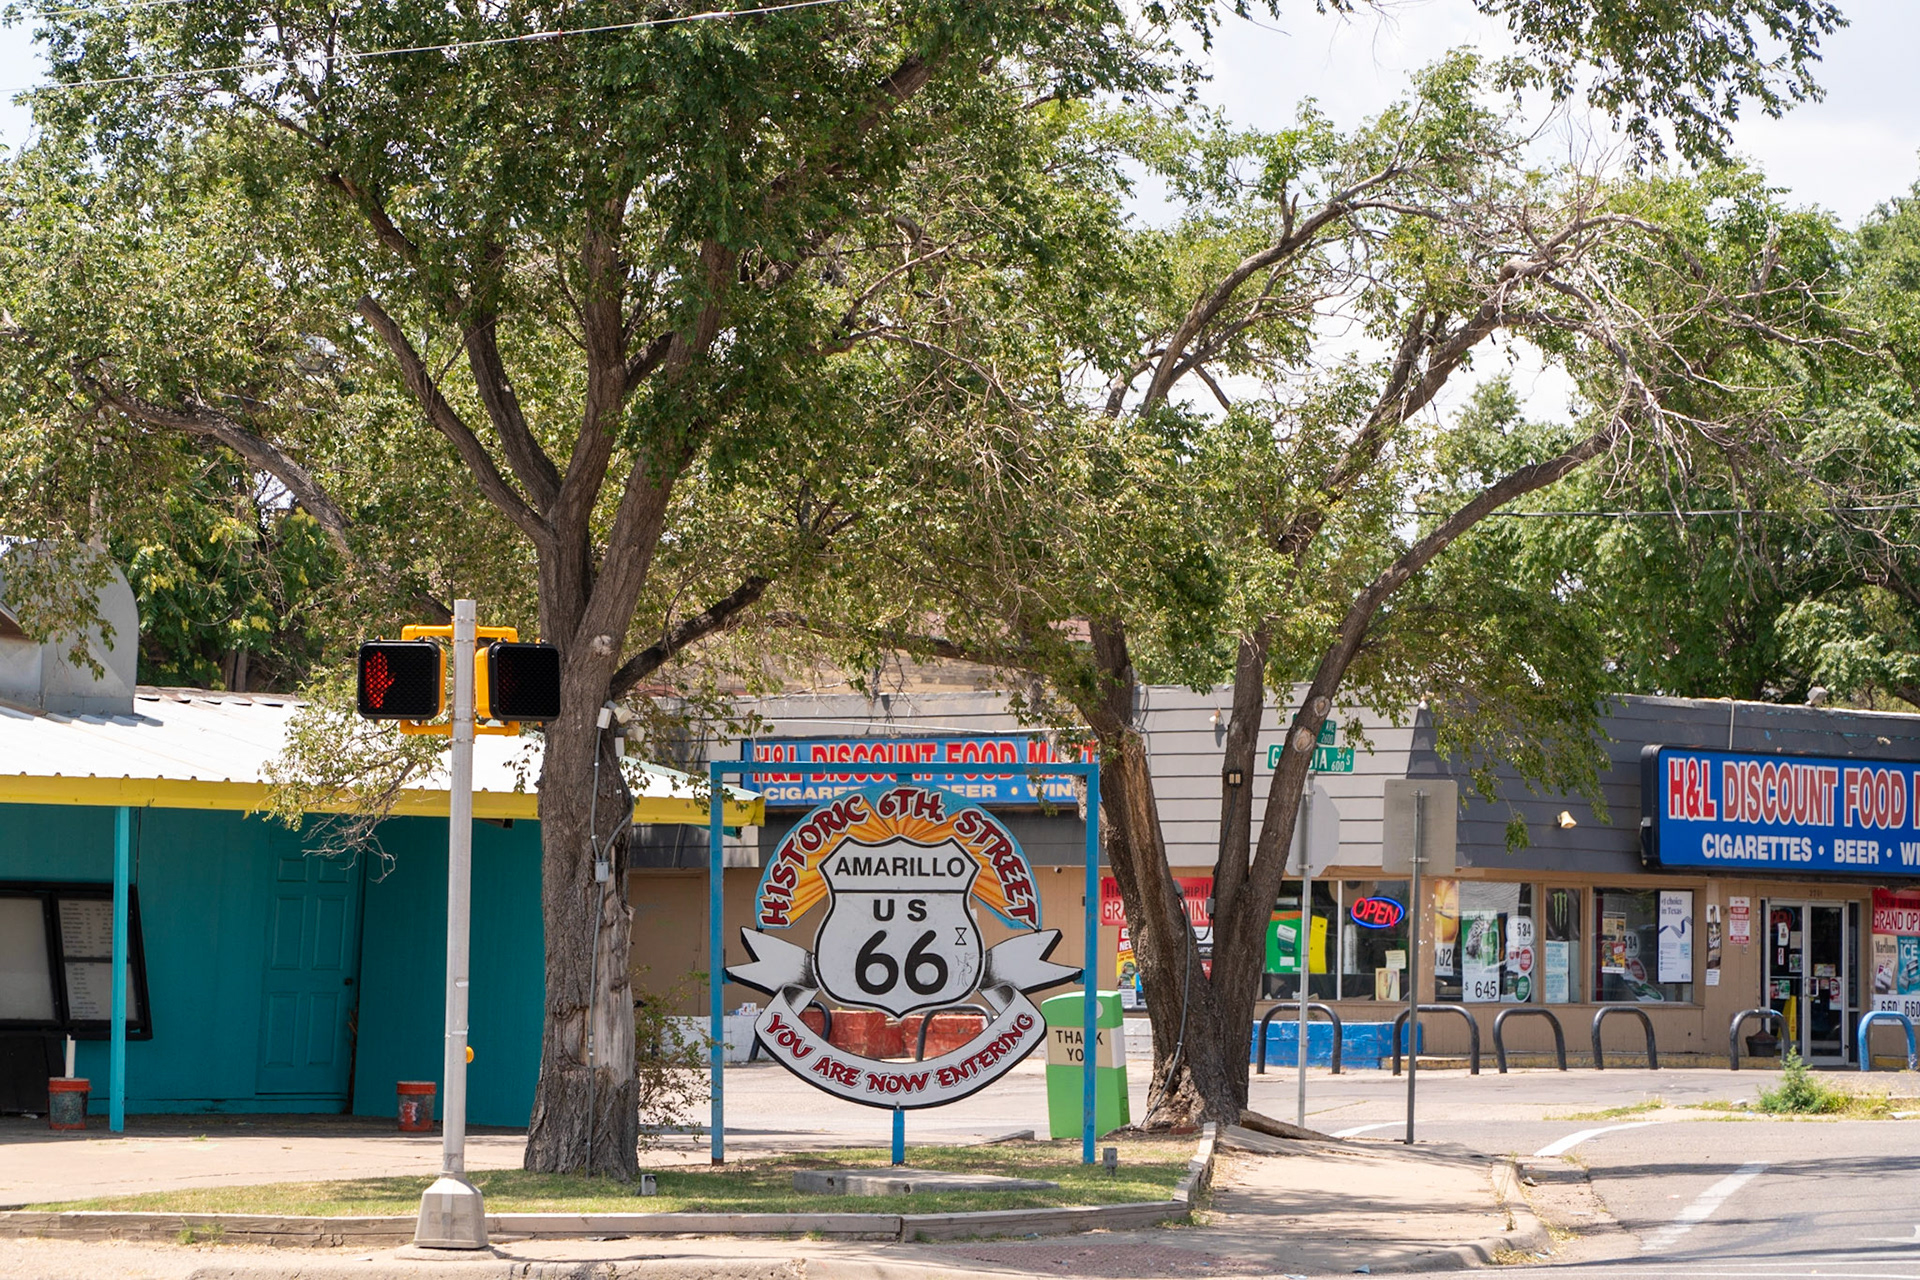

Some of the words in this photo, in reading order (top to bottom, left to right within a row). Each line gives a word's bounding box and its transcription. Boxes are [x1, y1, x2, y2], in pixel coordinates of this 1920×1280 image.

[1330, 760, 1345, 772] 600
[1026, 783, 1074, 797] WIN
[1668, 757, 1717, 821] H&L
[1722, 760, 1838, 827] DISCOUNT
[1844, 766, 1907, 830] FOOD
[1702, 833, 1812, 863] CIGARETTES
[1834, 839, 1879, 865] BEER
[760, 794, 869, 925] HISTORIC
[954, 810, 1038, 926] STREET
[834, 857, 966, 878] AMARILLO
[1353, 897, 1399, 926] OPEN
[1874, 910, 1903, 930] GRAND
[1435, 948, 1452, 967] 02
[1900, 942, 1918, 961] ICE
[855, 930, 949, 996] 66
[1055, 1030, 1103, 1046] THAK
[766, 1014, 813, 1058] YOU
[812, 1057, 862, 1087] ARE
[866, 1072, 930, 1093] NOW
[936, 1014, 1034, 1087] ENTERING
[1066, 1047, 1084, 1062] YO
